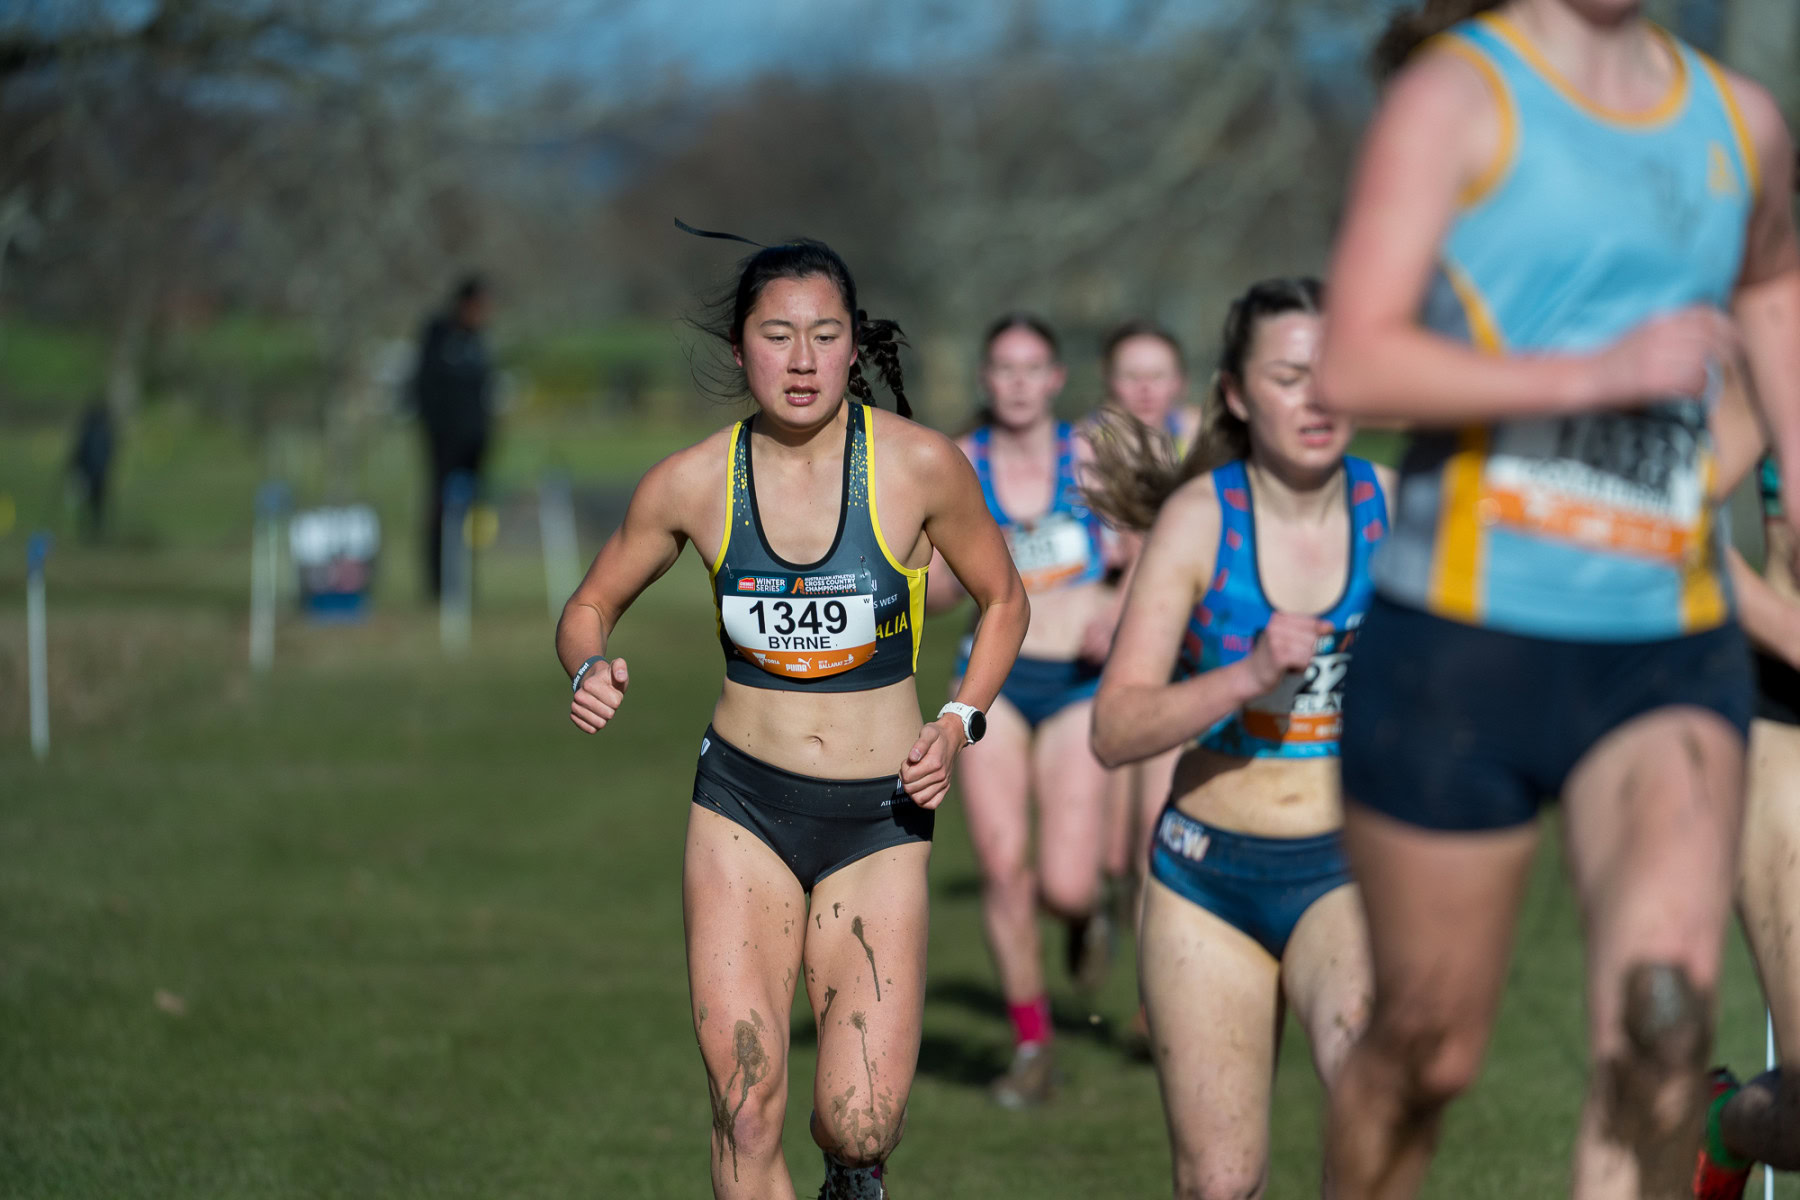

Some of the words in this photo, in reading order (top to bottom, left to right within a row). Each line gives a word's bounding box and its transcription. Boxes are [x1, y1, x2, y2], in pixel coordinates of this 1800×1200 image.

[756, 578, 785, 586] WINTER
[805, 583, 856, 591] CHAMPIONSHIPS
[879, 594, 898, 607] WEST
[749, 600, 847, 634] 1349
[768, 636, 831, 650] BYRNE
[786, 664, 807, 672] PUMA
